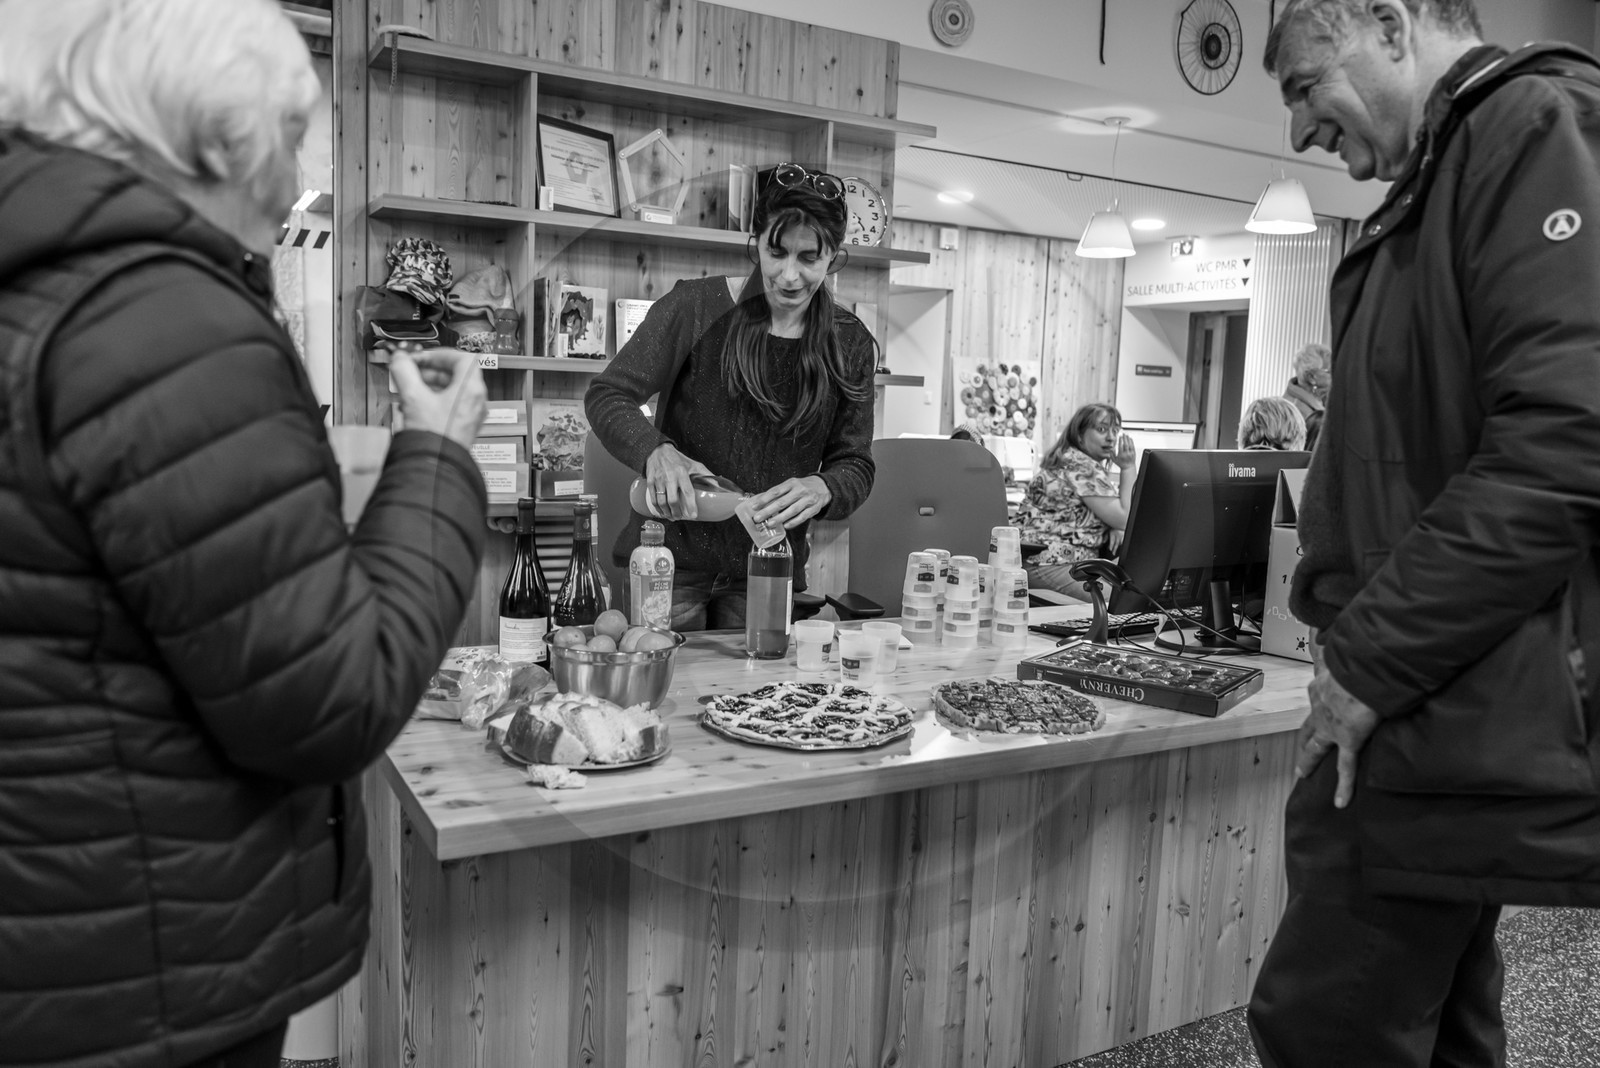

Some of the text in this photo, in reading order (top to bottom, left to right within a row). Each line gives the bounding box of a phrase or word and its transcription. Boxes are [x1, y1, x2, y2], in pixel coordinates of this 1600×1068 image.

[848, 185, 857, 194] 12
[862, 189, 865, 198] 1
[868, 199, 875, 208] 2
[872, 212, 879, 221] 3
[870, 225, 876, 233] 4
[852, 238, 859, 246] 6
[863, 234, 870, 242] 5
[1196, 259, 1237, 273] WC PMR
[1127, 284, 1153, 297] SALLE
[478, 357, 496, 367] vés
[1228, 463, 1256, 477] iiyama
[1081, 679, 1145, 701] CHEVERNY
